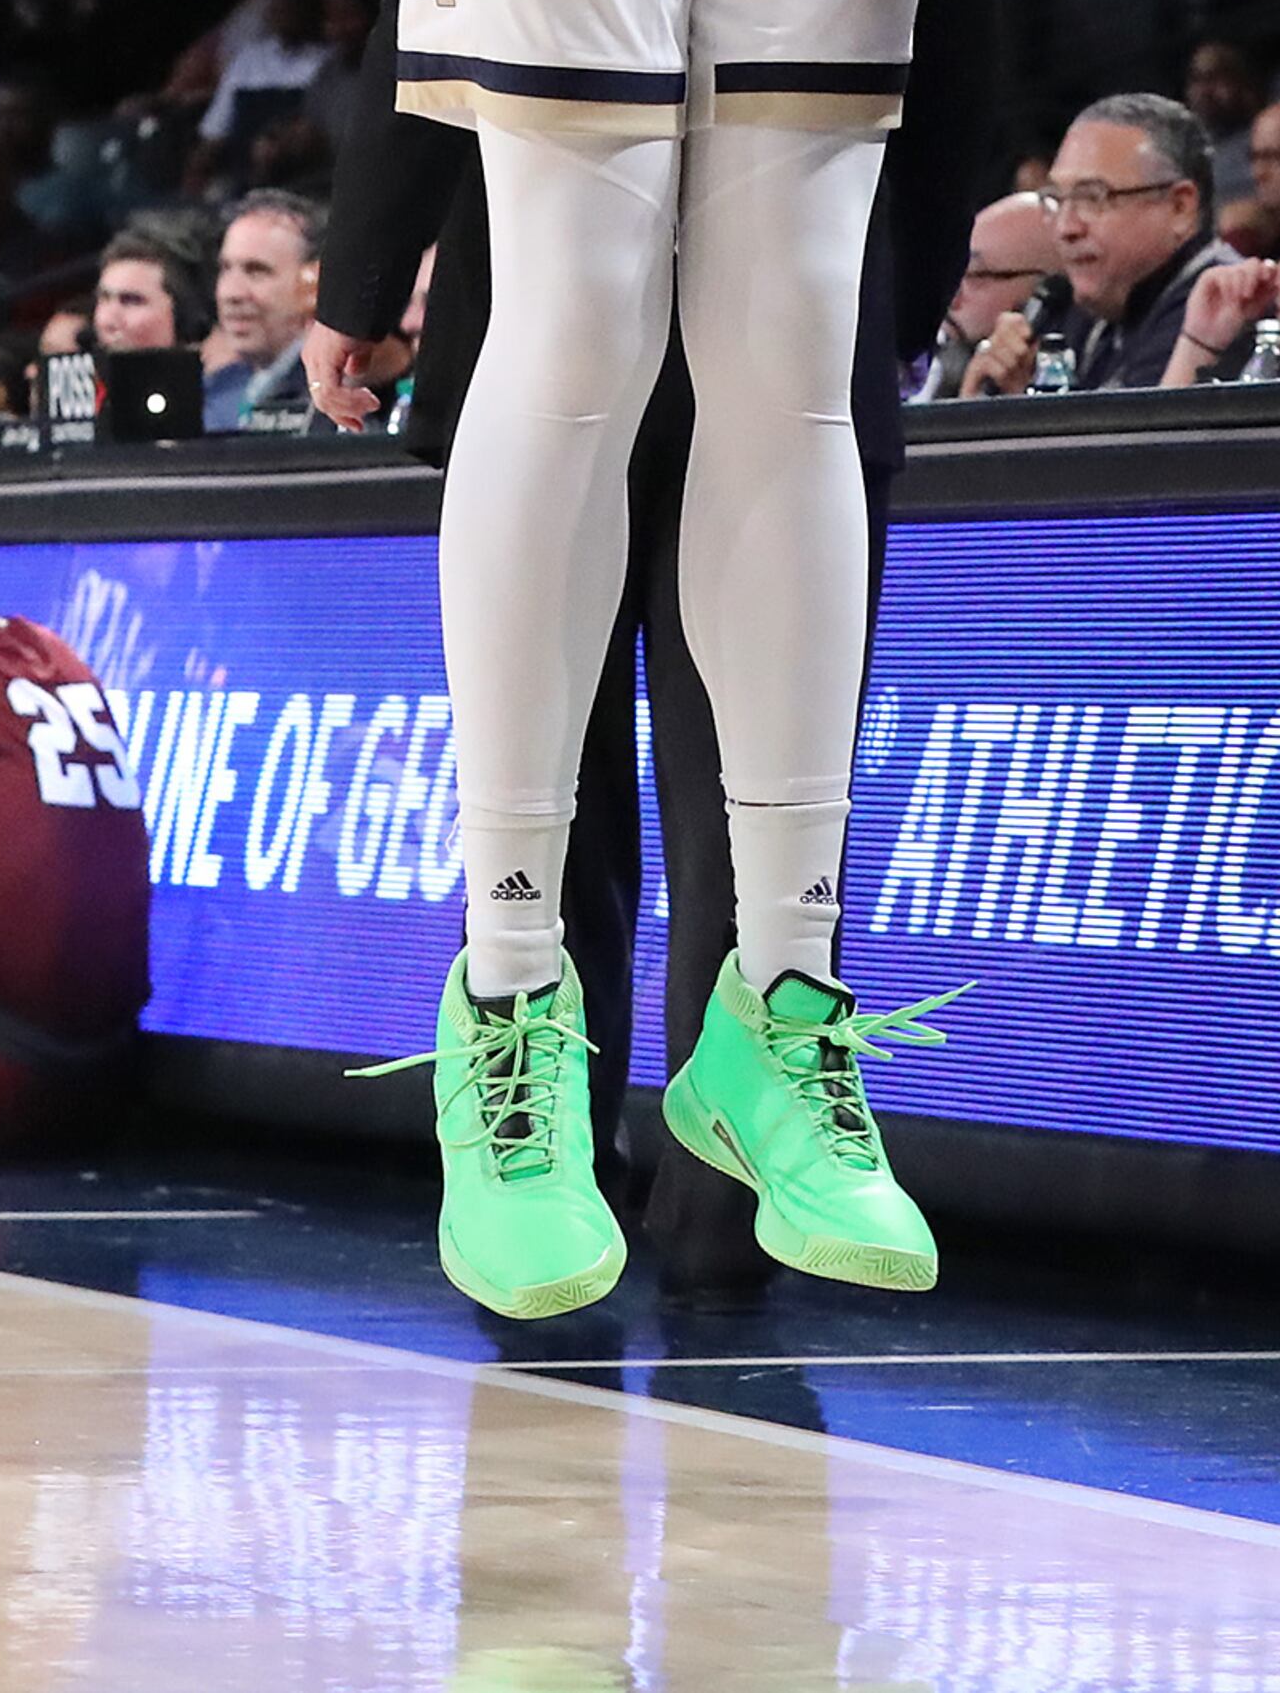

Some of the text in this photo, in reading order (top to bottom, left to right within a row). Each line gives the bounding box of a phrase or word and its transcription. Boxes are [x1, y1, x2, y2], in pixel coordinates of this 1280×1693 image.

[6, 677, 142, 809] 25
[245, 692, 358, 894] OF
[490, 888, 542, 901] adidas
